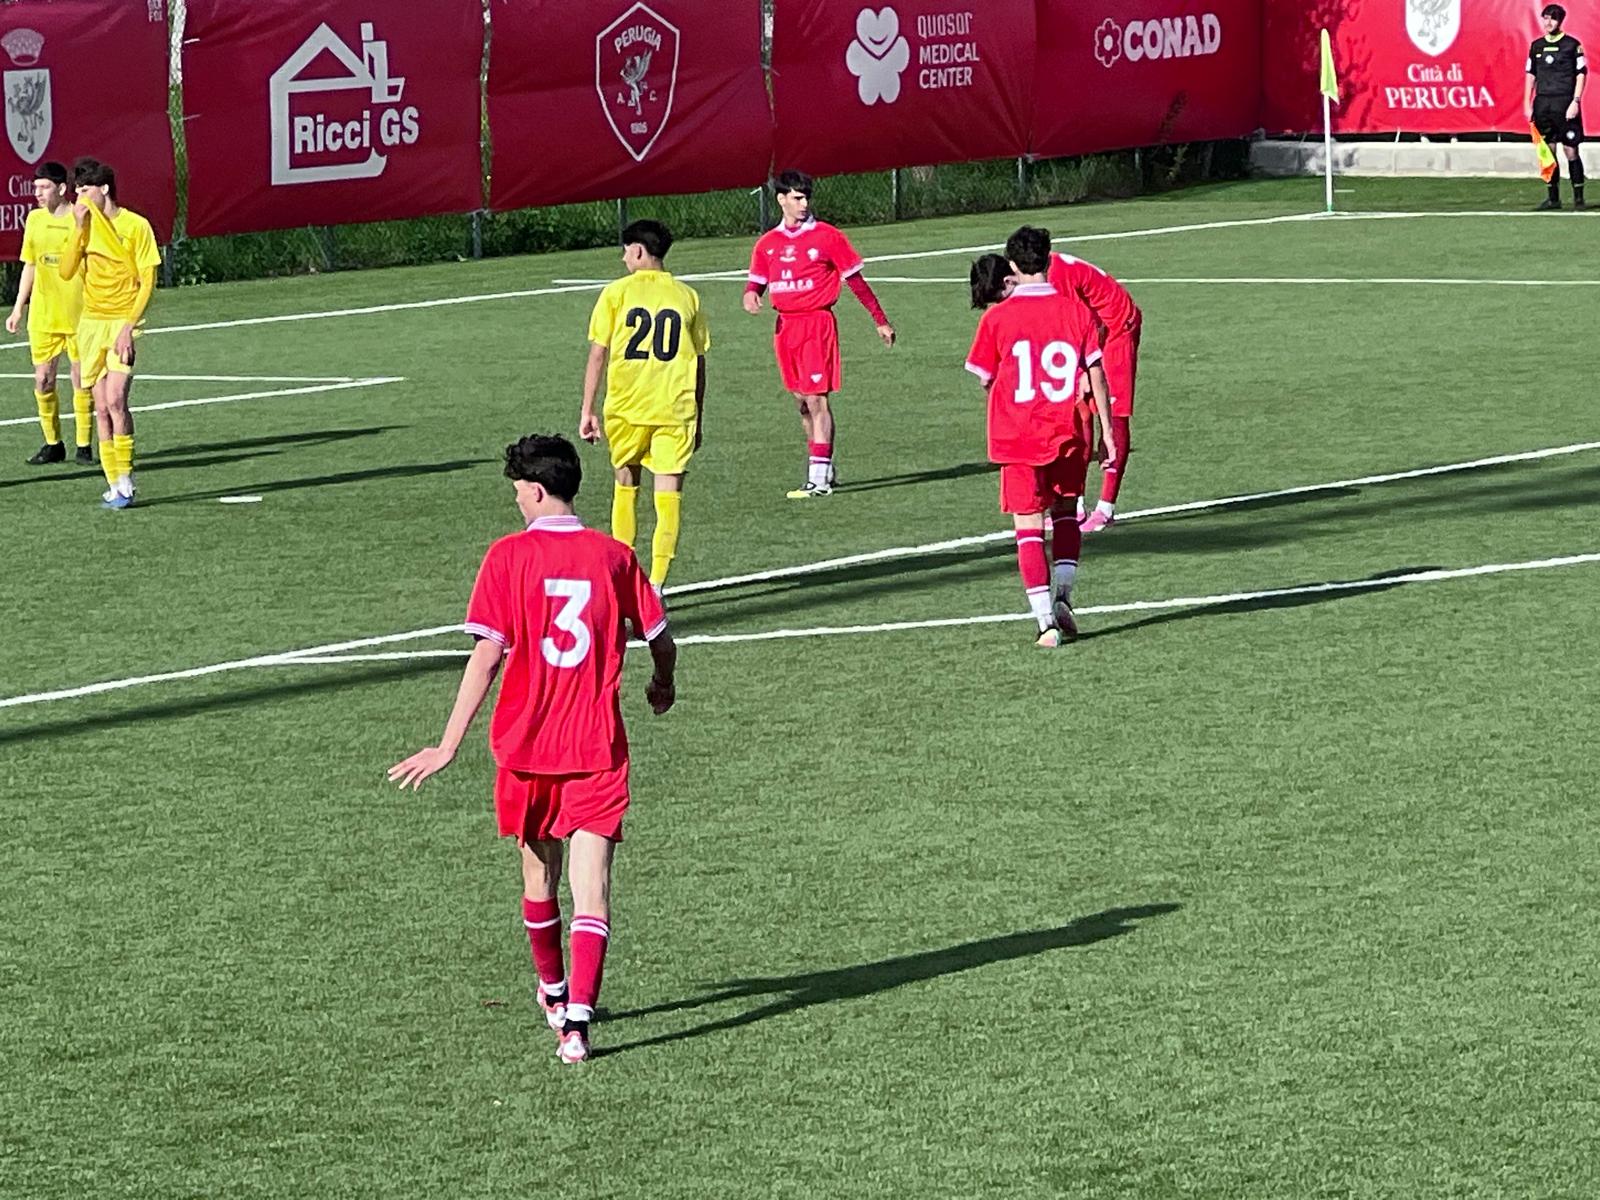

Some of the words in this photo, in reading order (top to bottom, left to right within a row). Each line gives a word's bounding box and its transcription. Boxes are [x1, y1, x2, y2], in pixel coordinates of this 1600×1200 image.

[614, 24, 662, 54] PERUGIA
[919, 42, 980, 65] MEDICAL
[1123, 13, 1221, 62] CONAD
[919, 66, 973, 89] CENTER
[1407, 63, 1443, 83] Città
[1447, 63, 1463, 82] di
[1385, 85, 1495, 109] PERUGIA
[293, 110, 370, 154] Ricci
[380, 106, 419, 146] GS
[624, 307, 682, 362] 20
[1011, 339, 1078, 404] 19
[540, 578, 592, 669] 3
